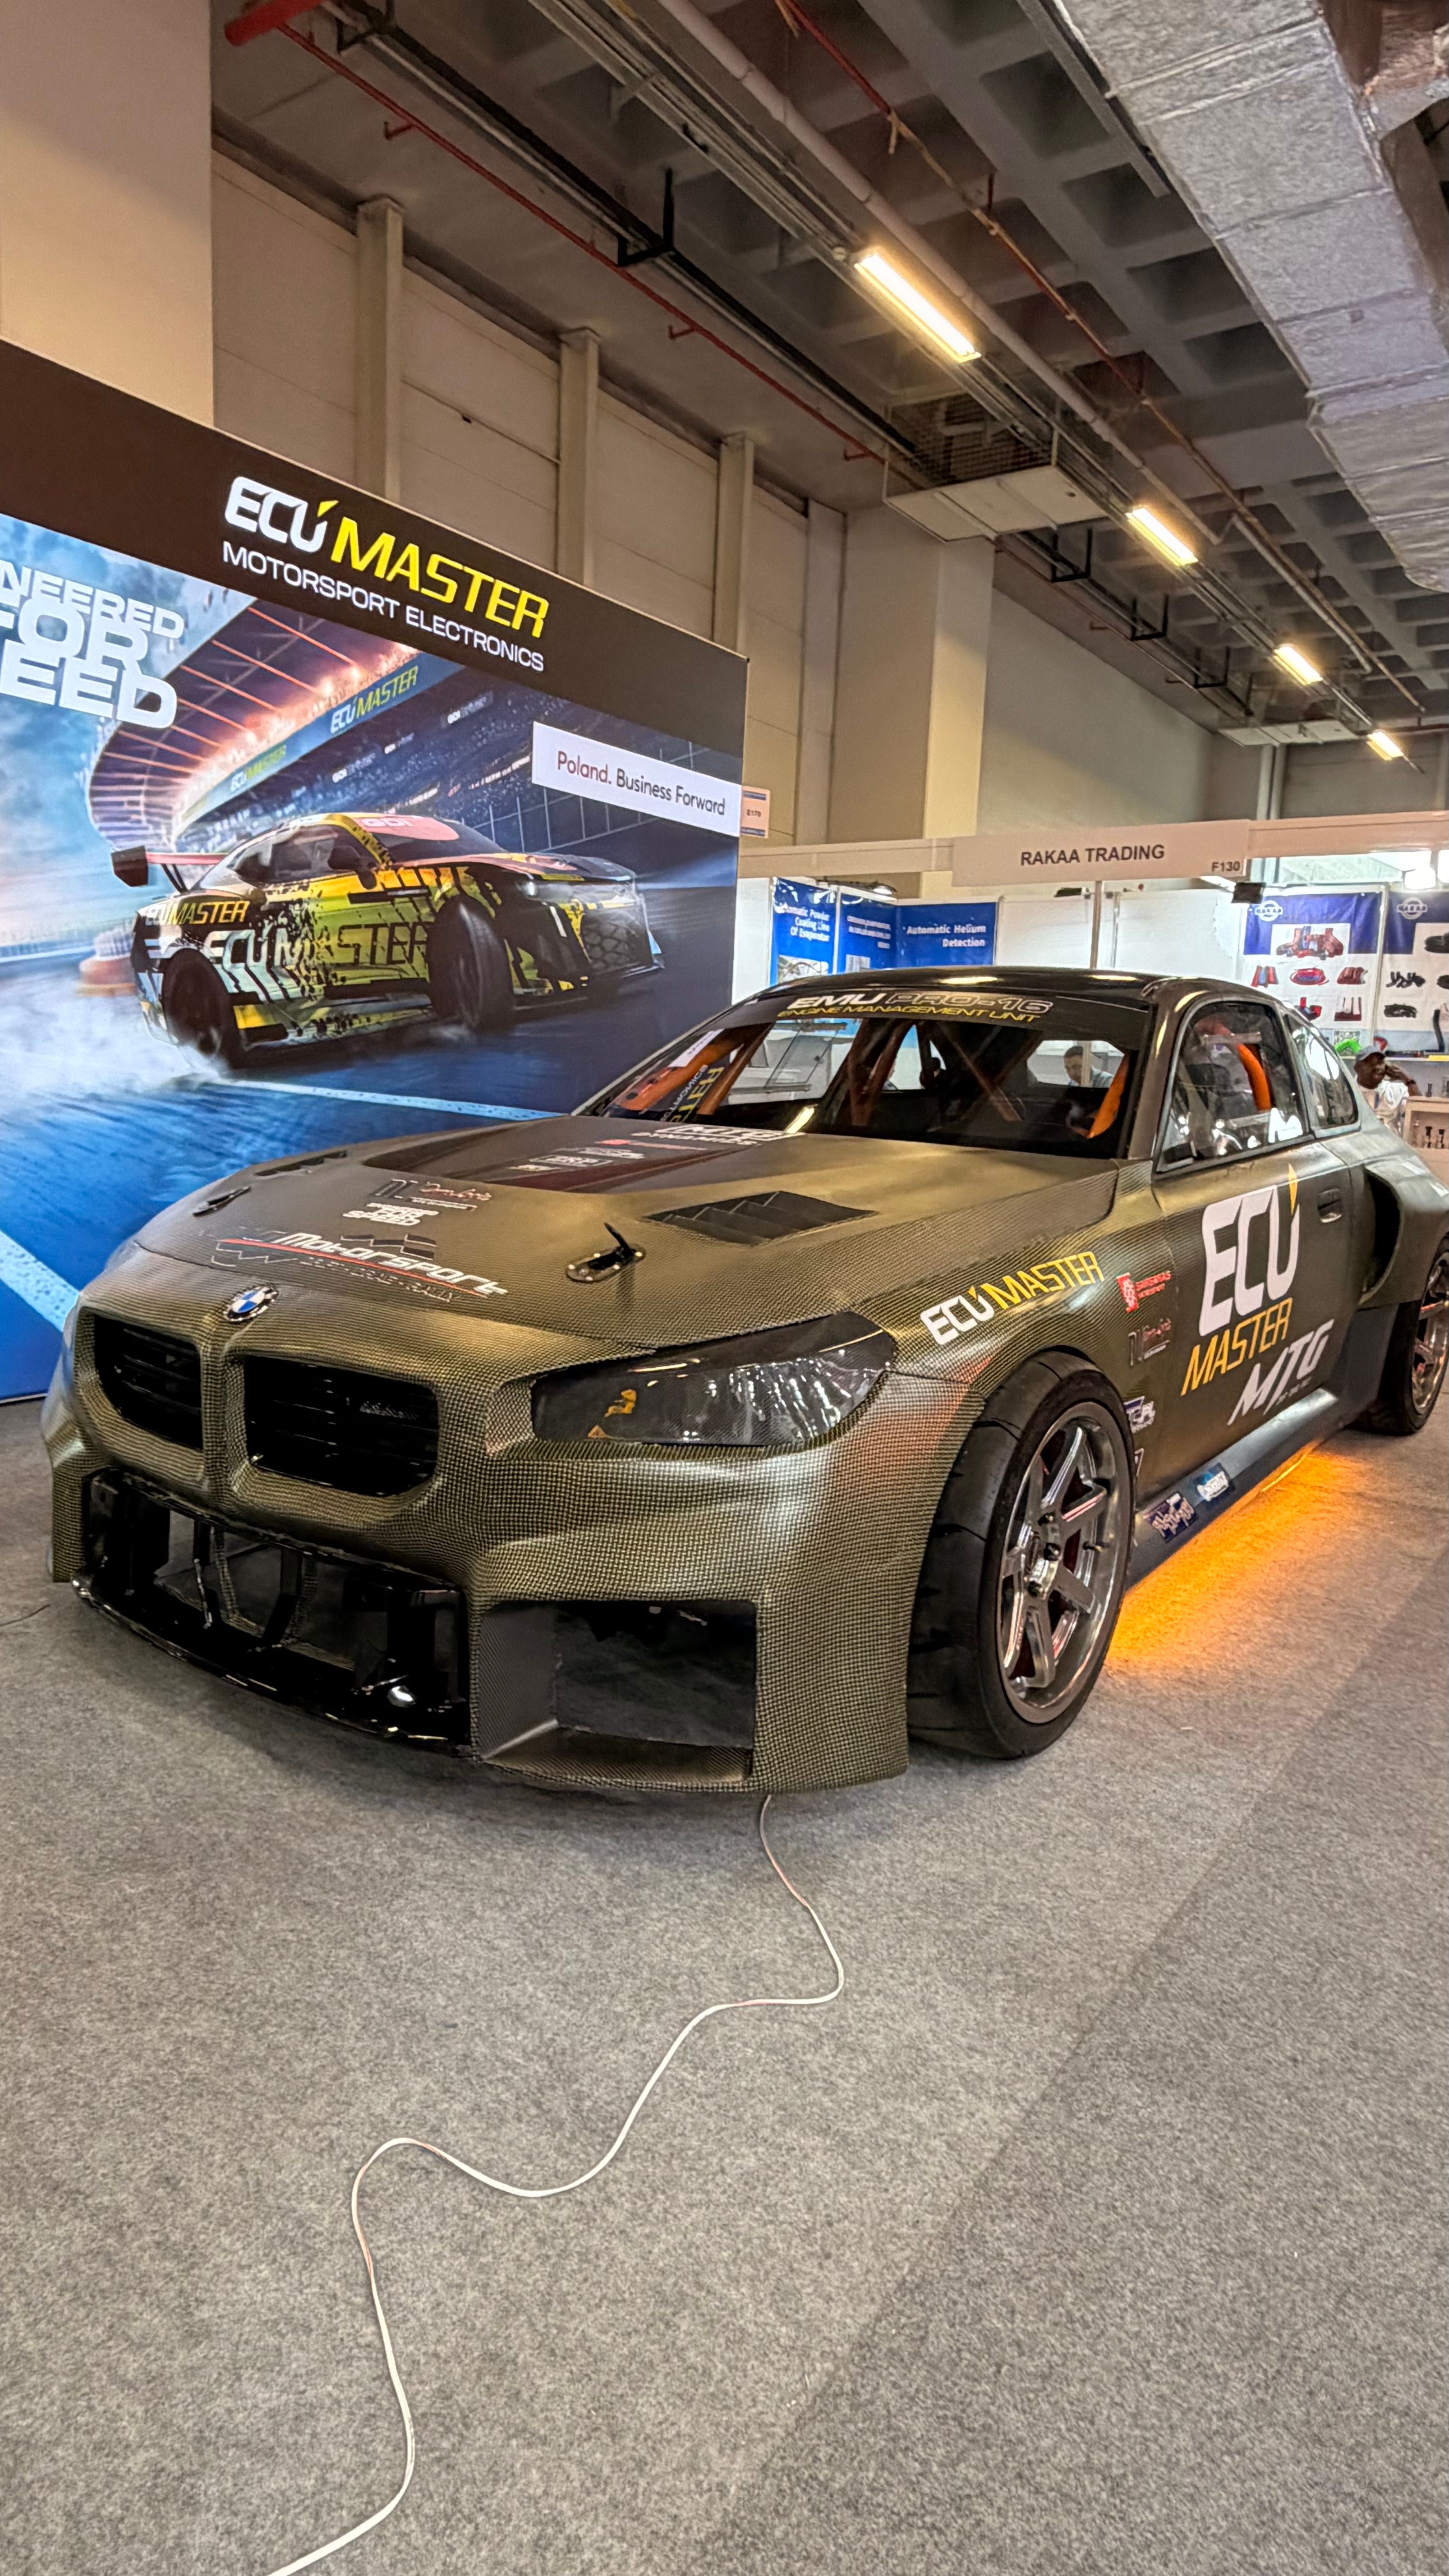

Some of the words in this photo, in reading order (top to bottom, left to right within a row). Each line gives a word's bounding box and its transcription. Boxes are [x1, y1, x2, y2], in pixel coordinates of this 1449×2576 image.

[223, 541, 400, 618] MOTORSPORT
[406, 607, 544, 672] ELECTRONICS
[557, 750, 612, 785] Poland.
[616, 768, 672, 801] Business
[675, 785, 725, 815] Forward
[1021, 849, 1080, 865] RAKAA
[1085, 844, 1165, 862] TRADING
[1211, 860, 1240, 872] F130
[906, 924, 951, 935] Automatic
[954, 924, 986, 934] Helium
[942, 937, 985, 947] Detection
[777, 1007, 843, 1017] ENGINE
[843, 1005, 990, 1017] MANAGEMENT
[989, 1012, 1042, 1023] UNIT
[787, 993, 888, 1010] EMU
[886, 993, 1053, 1014] PRO-16
[272, 1232, 508, 1295] Motorsport
[1181, 1297, 1293, 1396] MASTER
